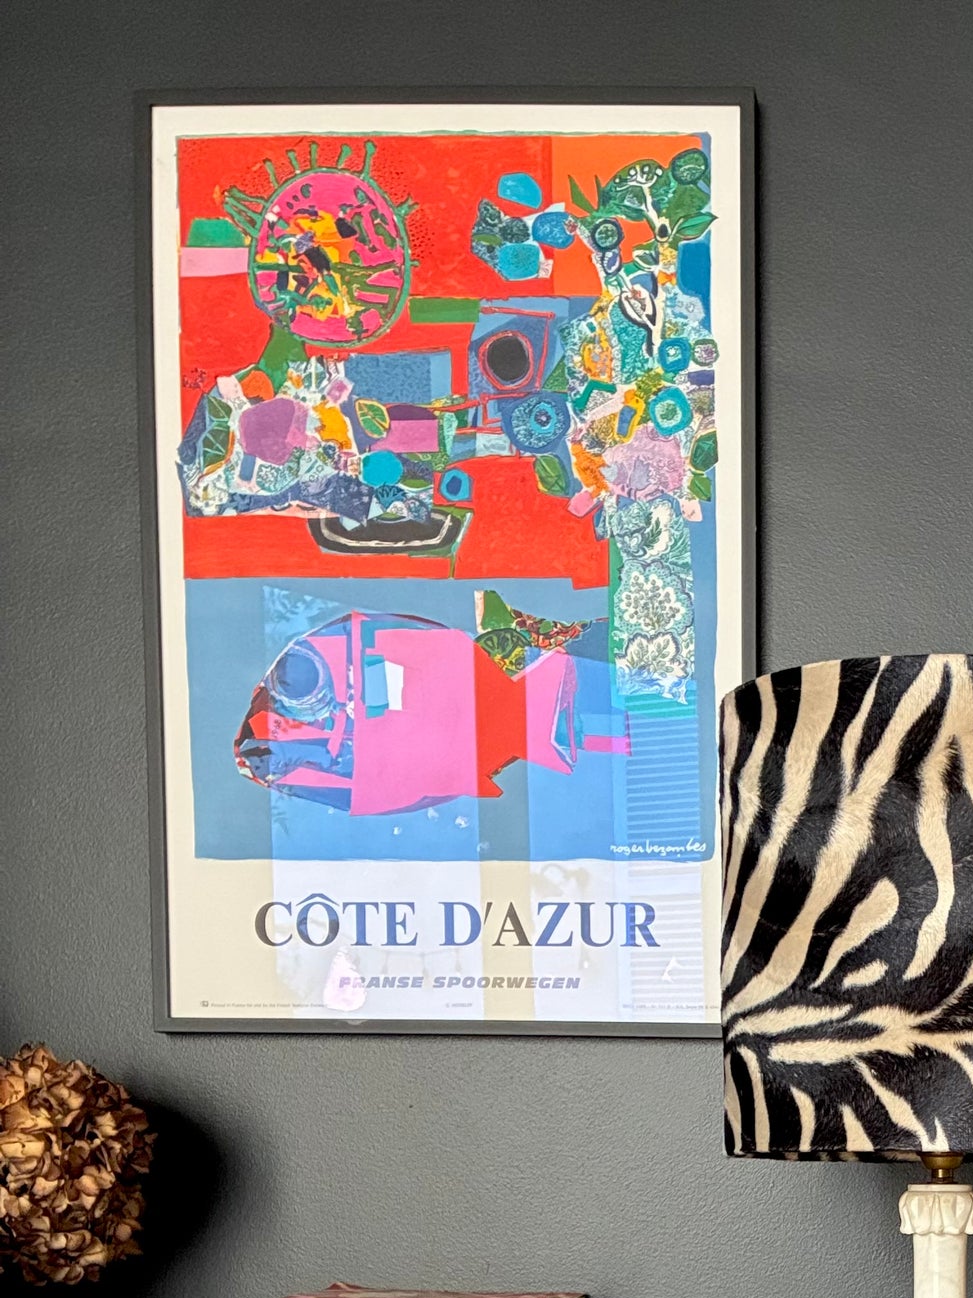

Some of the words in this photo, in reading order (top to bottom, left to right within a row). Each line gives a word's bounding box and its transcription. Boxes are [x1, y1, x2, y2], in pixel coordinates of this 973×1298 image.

[254, 893, 419, 948] CÔTE
[438, 901, 661, 948] D'AZUR
[338, 976, 424, 989] FRANSE
[432, 976, 581, 989] SPOORWEGEN
